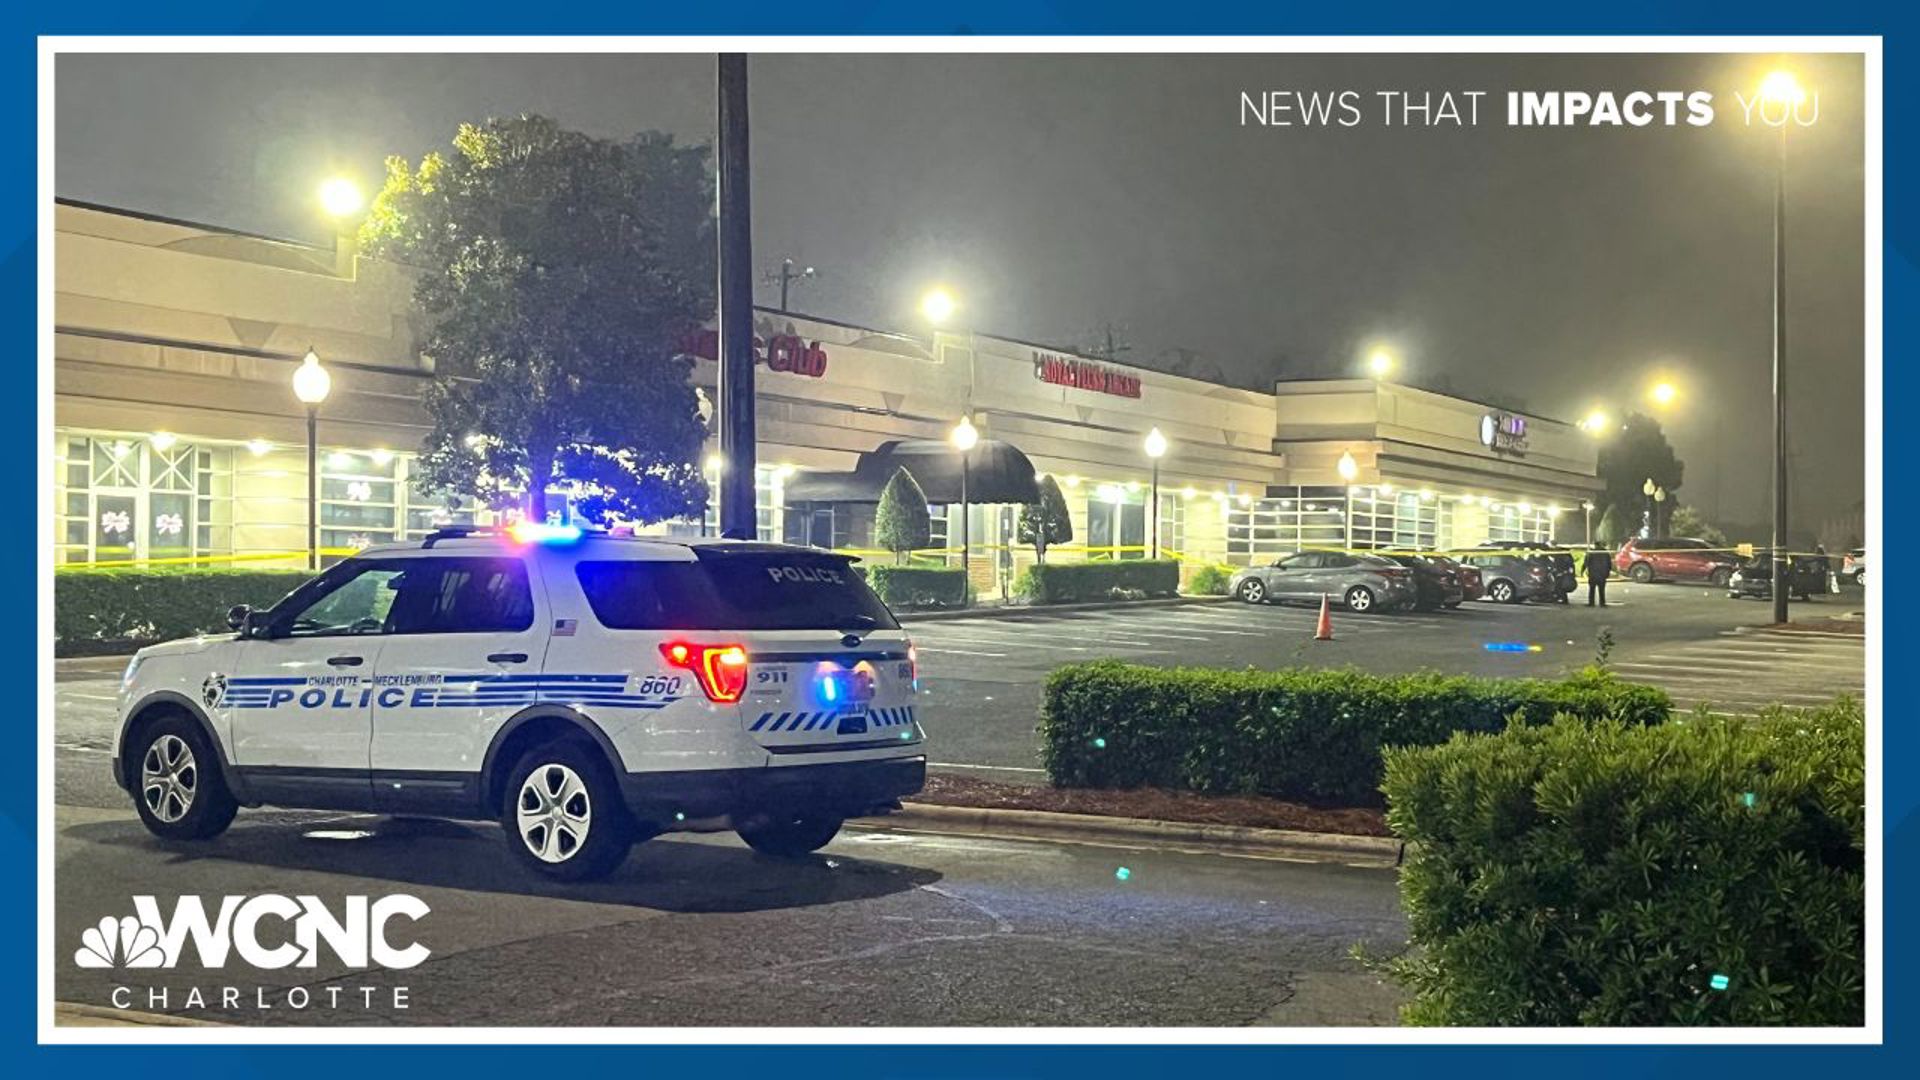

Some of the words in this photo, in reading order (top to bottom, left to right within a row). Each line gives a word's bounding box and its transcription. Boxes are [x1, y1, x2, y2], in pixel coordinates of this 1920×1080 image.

[768, 334, 827, 378] Club
[767, 566, 845, 585] POLICE
[308, 675, 359, 687] CHARLOTTE
[373, 674, 442, 686] MECKLENBURG
[756, 671, 787, 683] 911
[269, 688, 438, 708] POLICE
